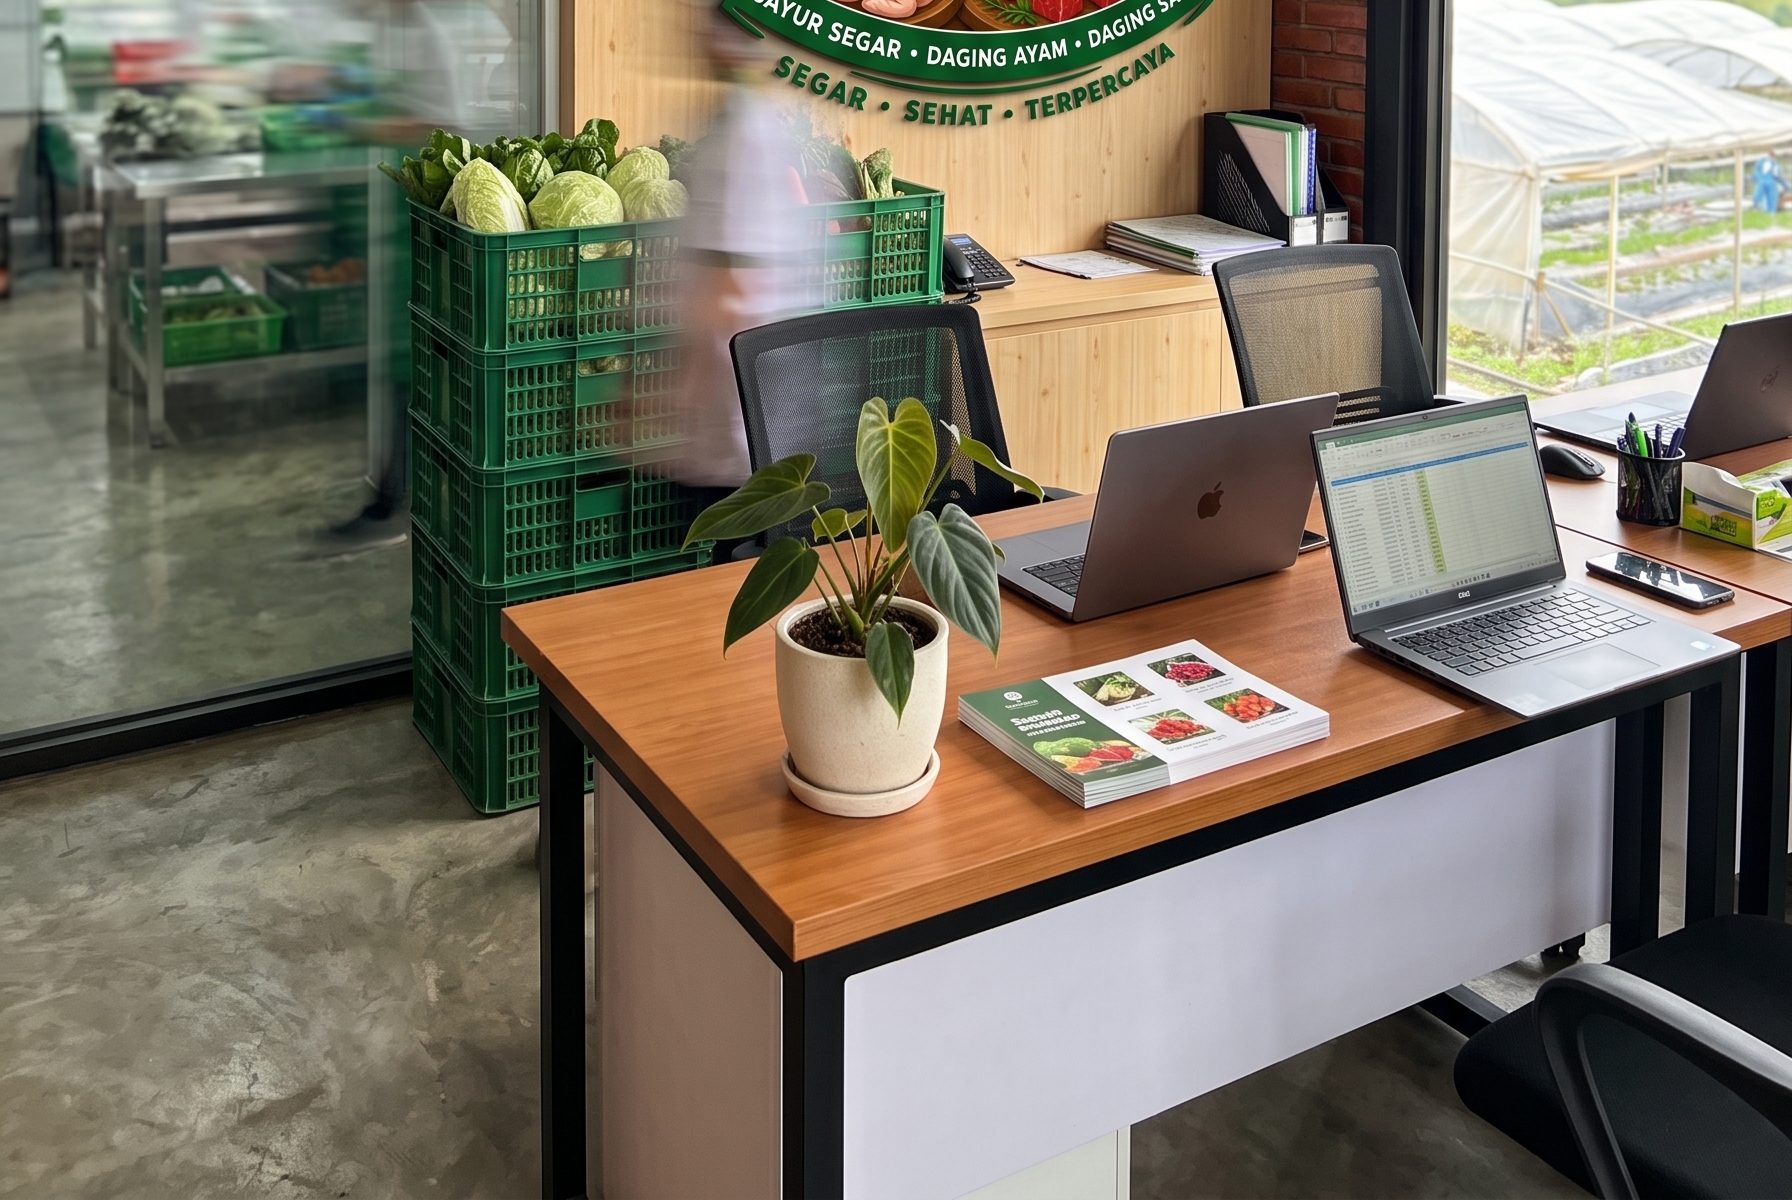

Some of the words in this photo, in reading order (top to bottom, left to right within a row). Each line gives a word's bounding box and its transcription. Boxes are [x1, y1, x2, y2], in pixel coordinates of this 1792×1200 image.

[828, 22, 901, 59] SEGAR
[927, 45, 1007, 67] DAGING
[1014, 38, 1068, 65] AYAM
[1088, 3, 1156, 48] DAGING
[774, 55, 868, 111] SEGAR
[904, 99, 993, 126] SEHAT
[1025, 42, 1175, 120] TERPERCAYA
